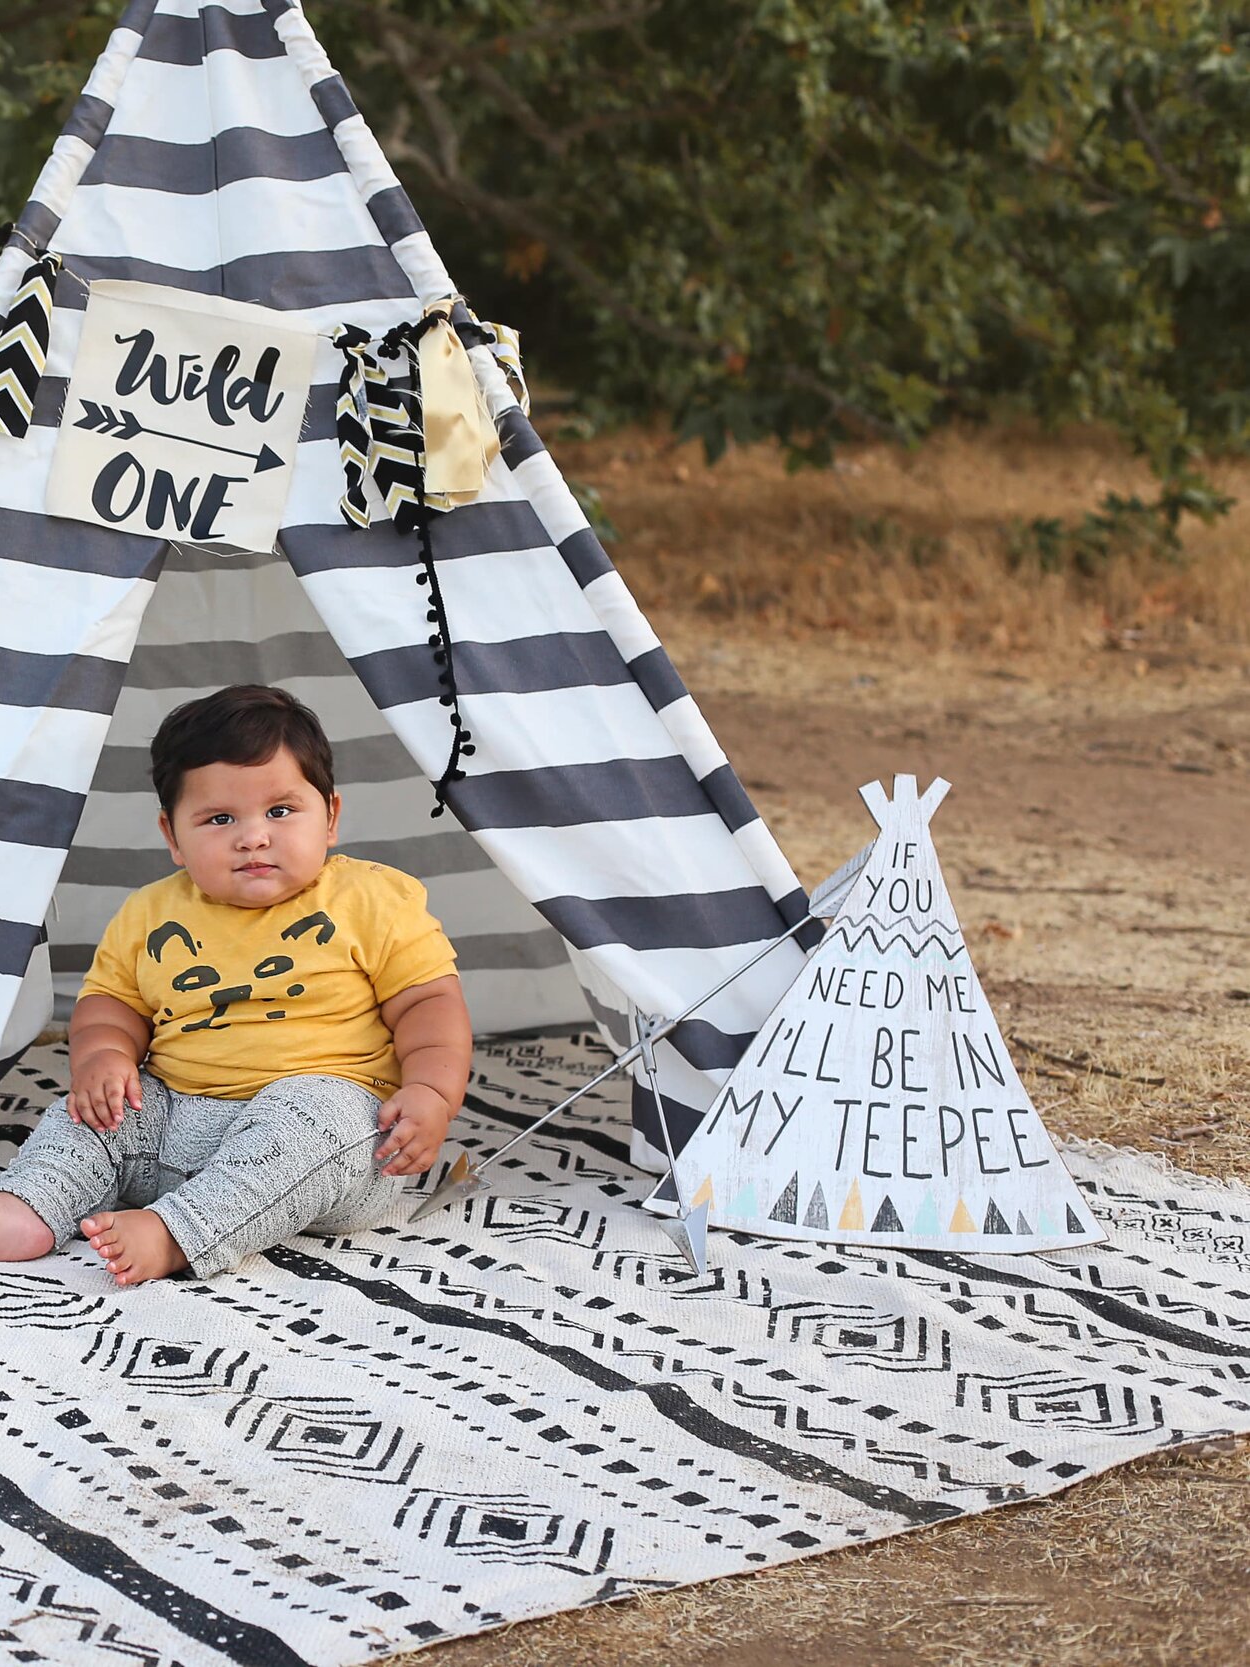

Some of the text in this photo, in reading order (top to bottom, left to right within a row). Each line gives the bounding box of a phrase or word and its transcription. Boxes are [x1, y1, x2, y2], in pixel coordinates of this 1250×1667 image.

[114, 328, 284, 426] Wild
[91, 451, 249, 540] ONE
[892, 842, 918, 869] IF
[866, 875, 932, 914] YOU
[808, 966, 977, 1013] NEED ME
[757, 1017, 1006, 1093] I'LL BE IN
[707, 1087, 1050, 1178] MY TEEPEE
